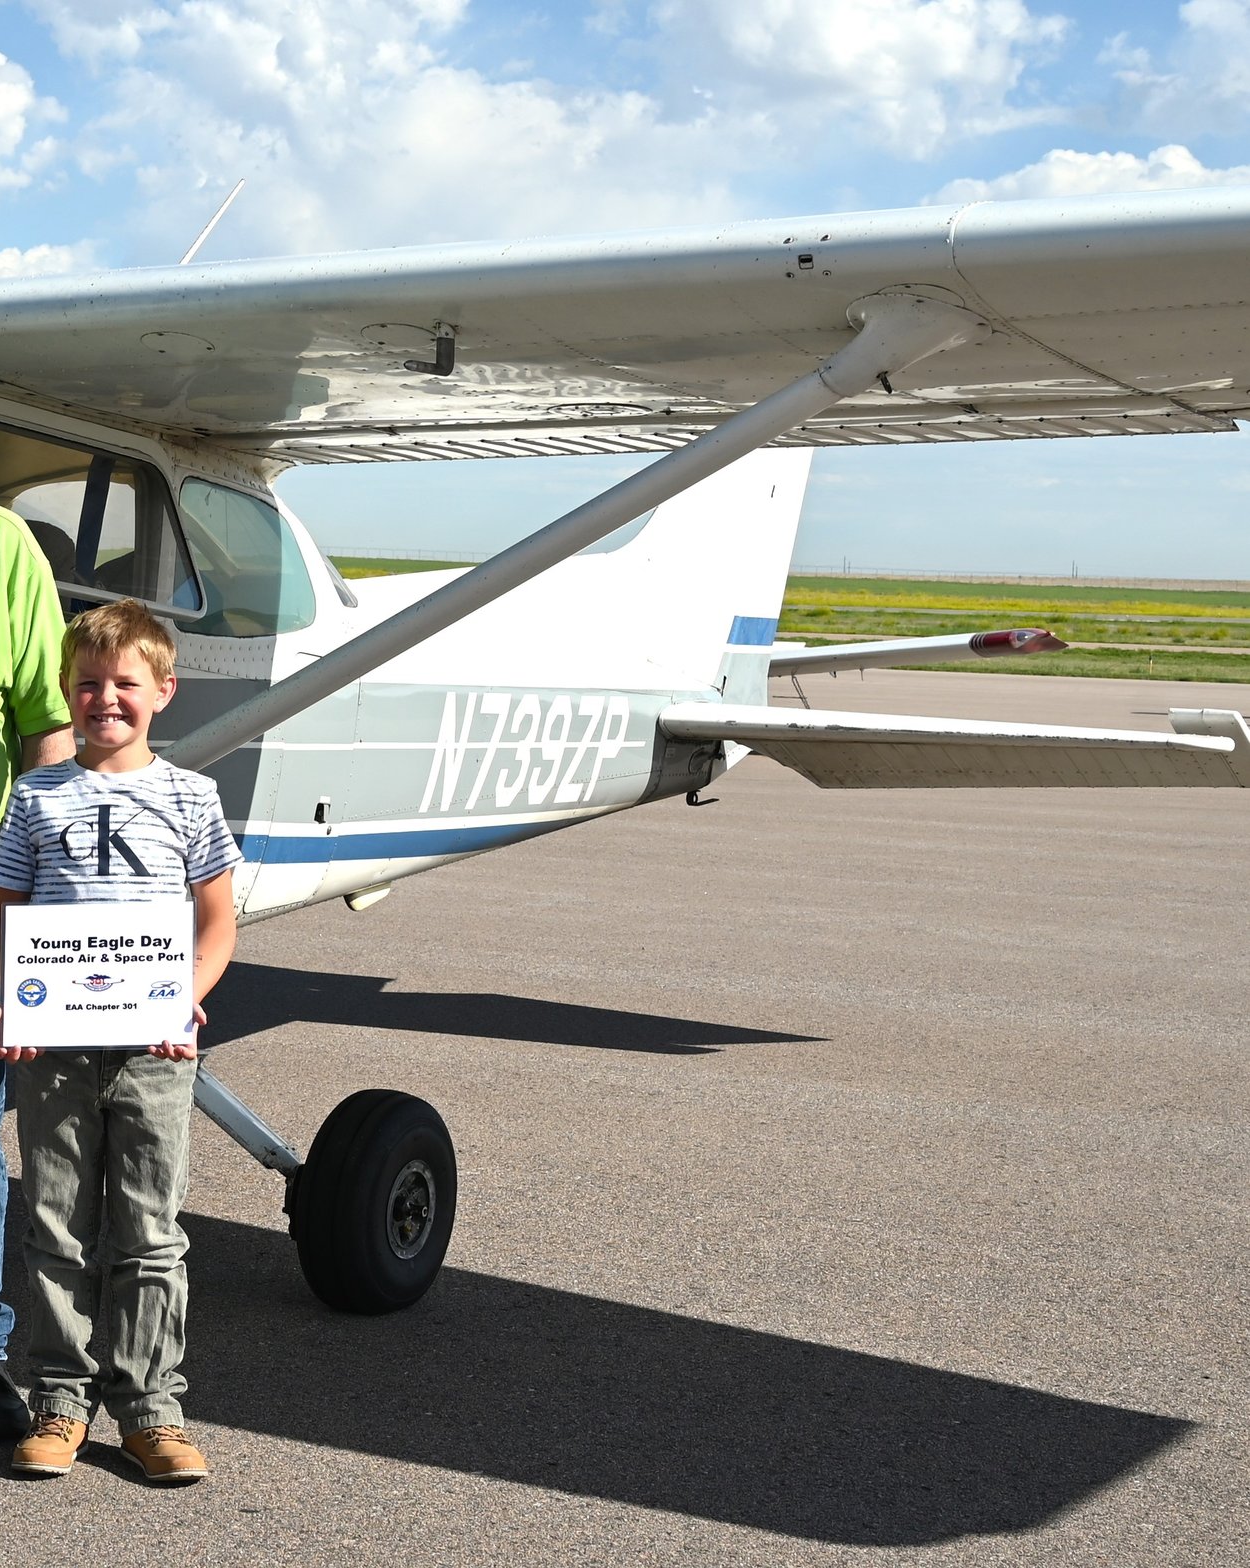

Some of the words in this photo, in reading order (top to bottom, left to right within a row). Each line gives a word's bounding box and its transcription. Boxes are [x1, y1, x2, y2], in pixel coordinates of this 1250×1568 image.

[418, 691, 630, 813] N739ZP
[30, 937, 81, 952] Young
[87, 936, 135, 951] Eagle
[140, 935, 172, 950] Day
[17, 954, 74, 965] Colorado
[77, 954, 97, 963] Air
[100, 953, 110, 963] &
[114, 953, 154, 964] Space
[157, 952, 185, 962] Port
[148, 989, 175, 998] EAA
[86, 1004, 120, 1012] Chapter
